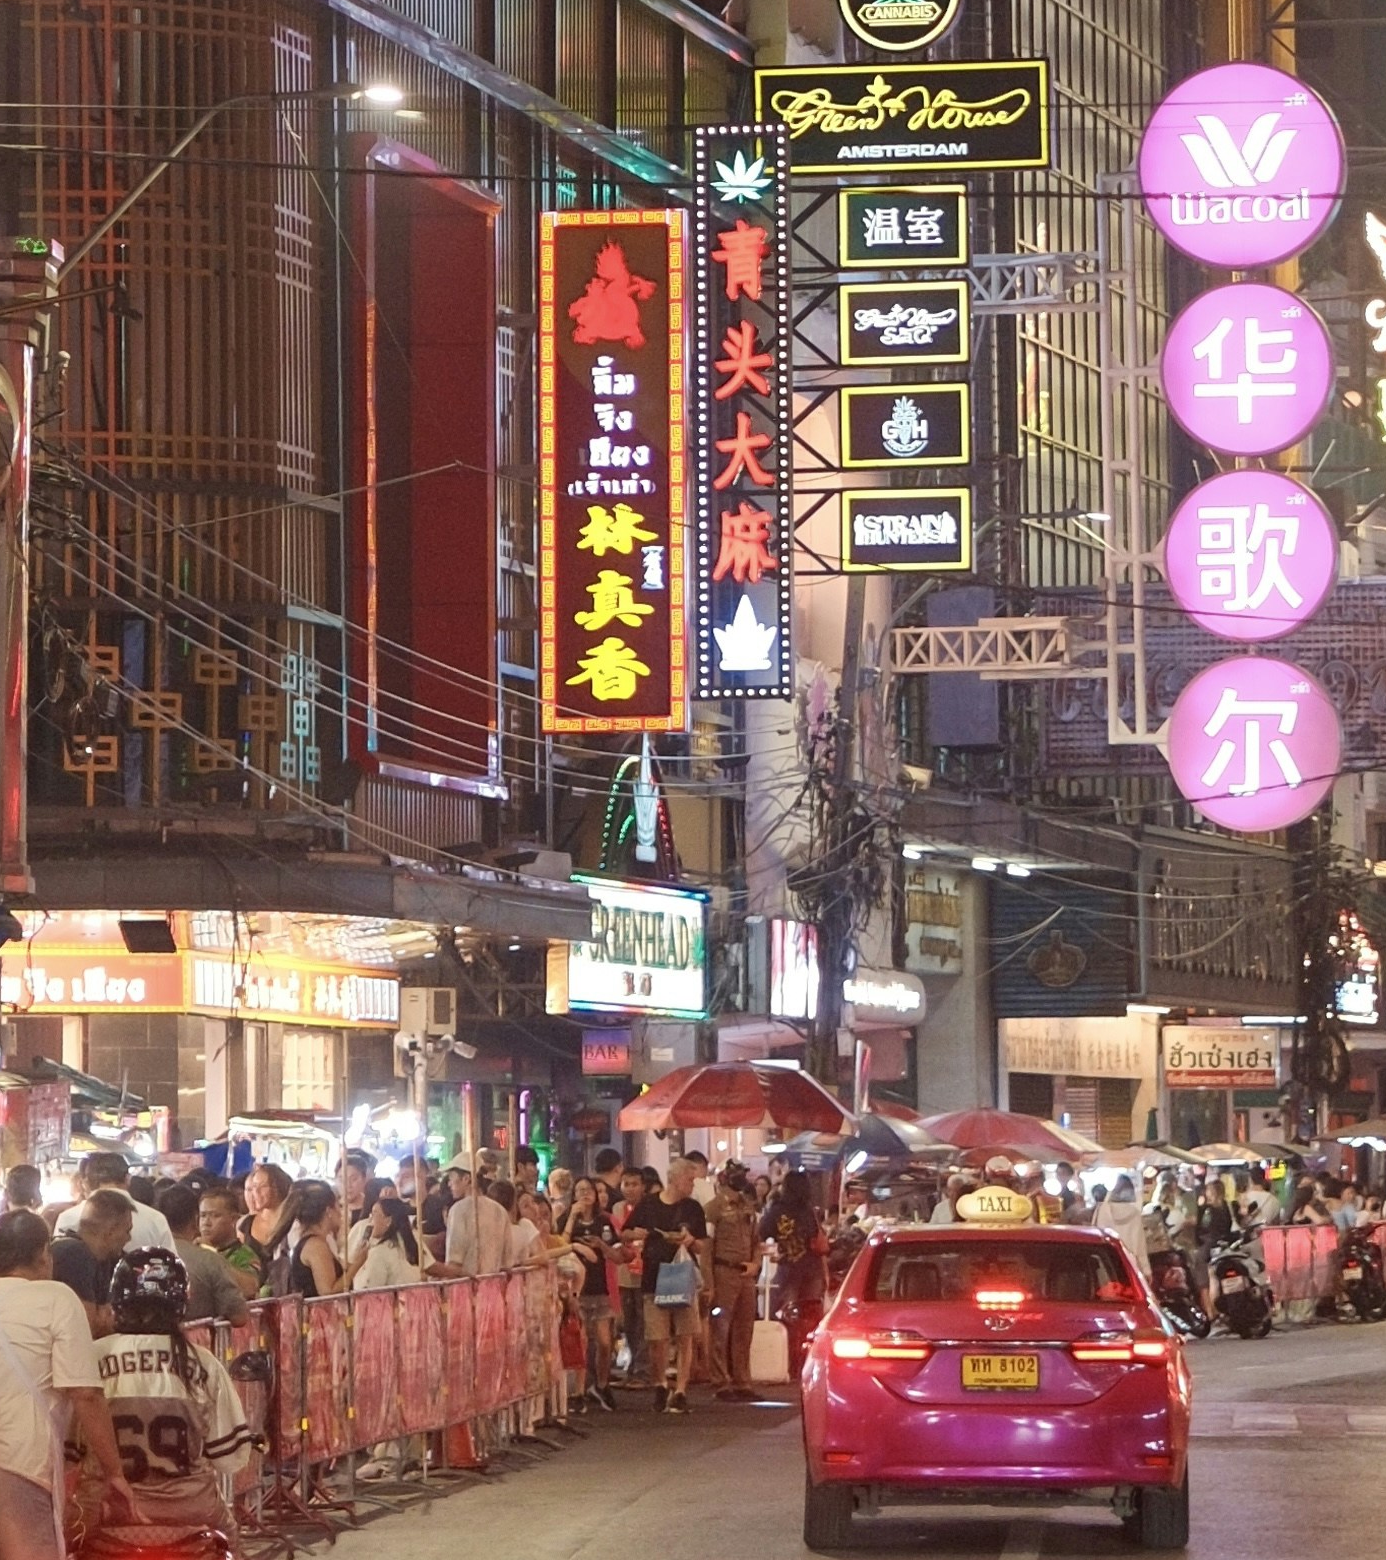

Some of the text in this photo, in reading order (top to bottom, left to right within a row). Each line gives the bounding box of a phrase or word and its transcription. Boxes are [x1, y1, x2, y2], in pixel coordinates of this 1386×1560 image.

[865, 4, 935, 20] CANNABIS
[836, 142, 969, 160] AMSTERDAM
[713, 221, 774, 583] 青头大麻
[566, 503, 659, 701] 林真香
[583, 1043, 620, 1061] BAR
[976, 1196, 1013, 1213] TAXI
[999, 1357, 1036, 1373] 8102
